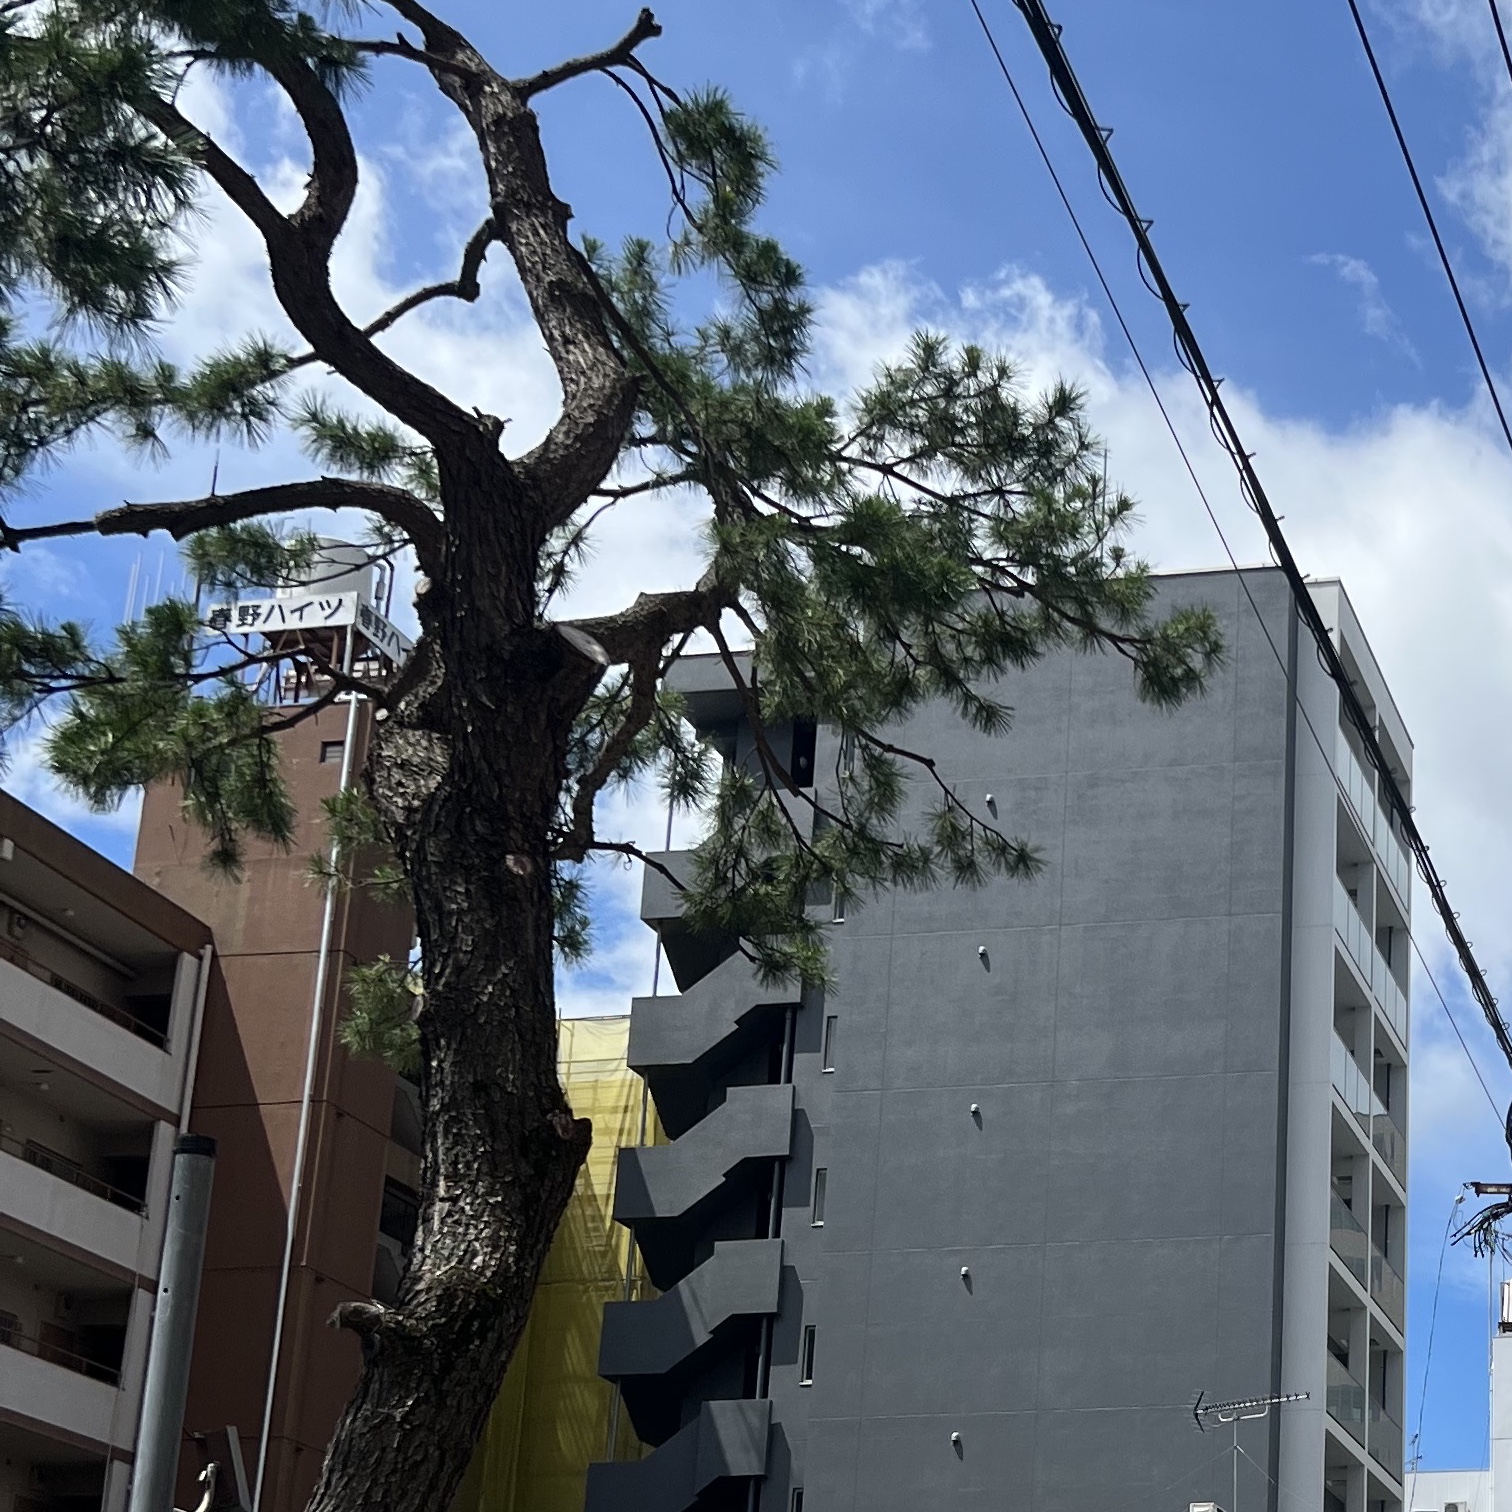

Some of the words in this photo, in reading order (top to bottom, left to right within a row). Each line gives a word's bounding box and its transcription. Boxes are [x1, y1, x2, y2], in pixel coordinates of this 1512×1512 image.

[211, 598, 344, 629] 春野ハイツ
[360, 603, 404, 658] 春野ハ
